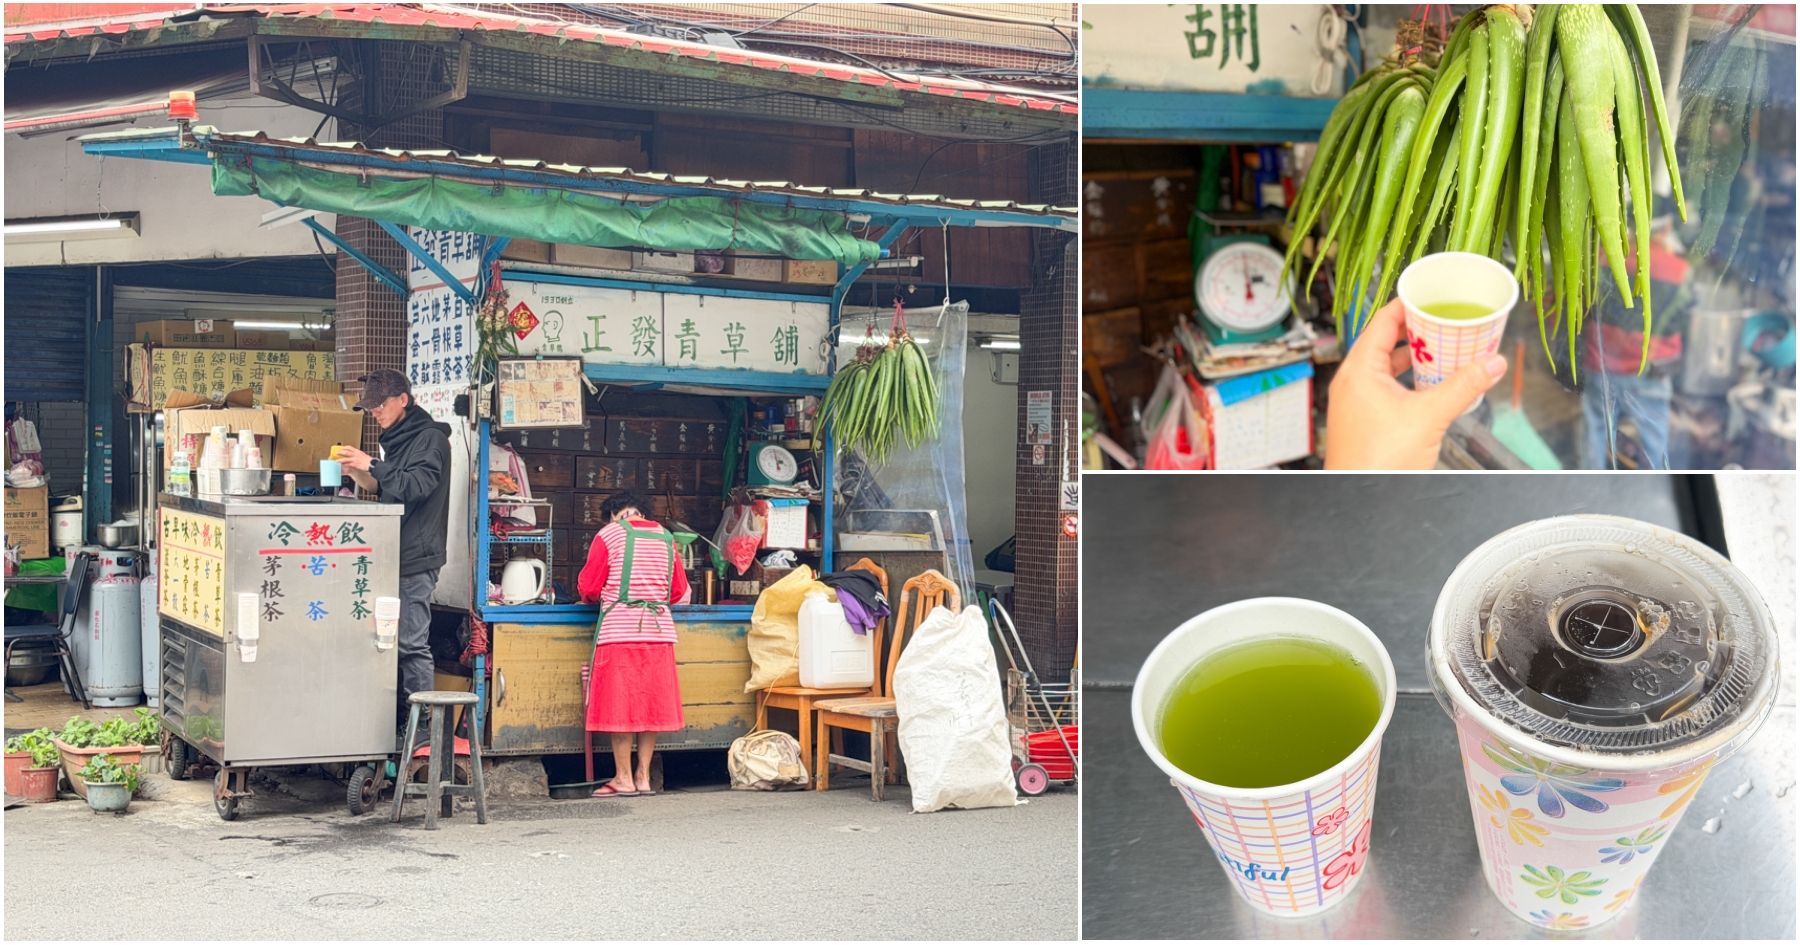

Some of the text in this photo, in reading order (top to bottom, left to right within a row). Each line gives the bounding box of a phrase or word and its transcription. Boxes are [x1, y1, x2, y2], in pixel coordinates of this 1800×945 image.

[581, 315, 799, 366] 正發青草舖
[163, 515, 223, 551] 古早味冷熱飲
[268, 520, 367, 546] 冷熱飲
[260, 555, 286, 622] 茅根茶
[305, 555, 329, 622] 苦茶
[349, 555, 373, 621] 青草茶
